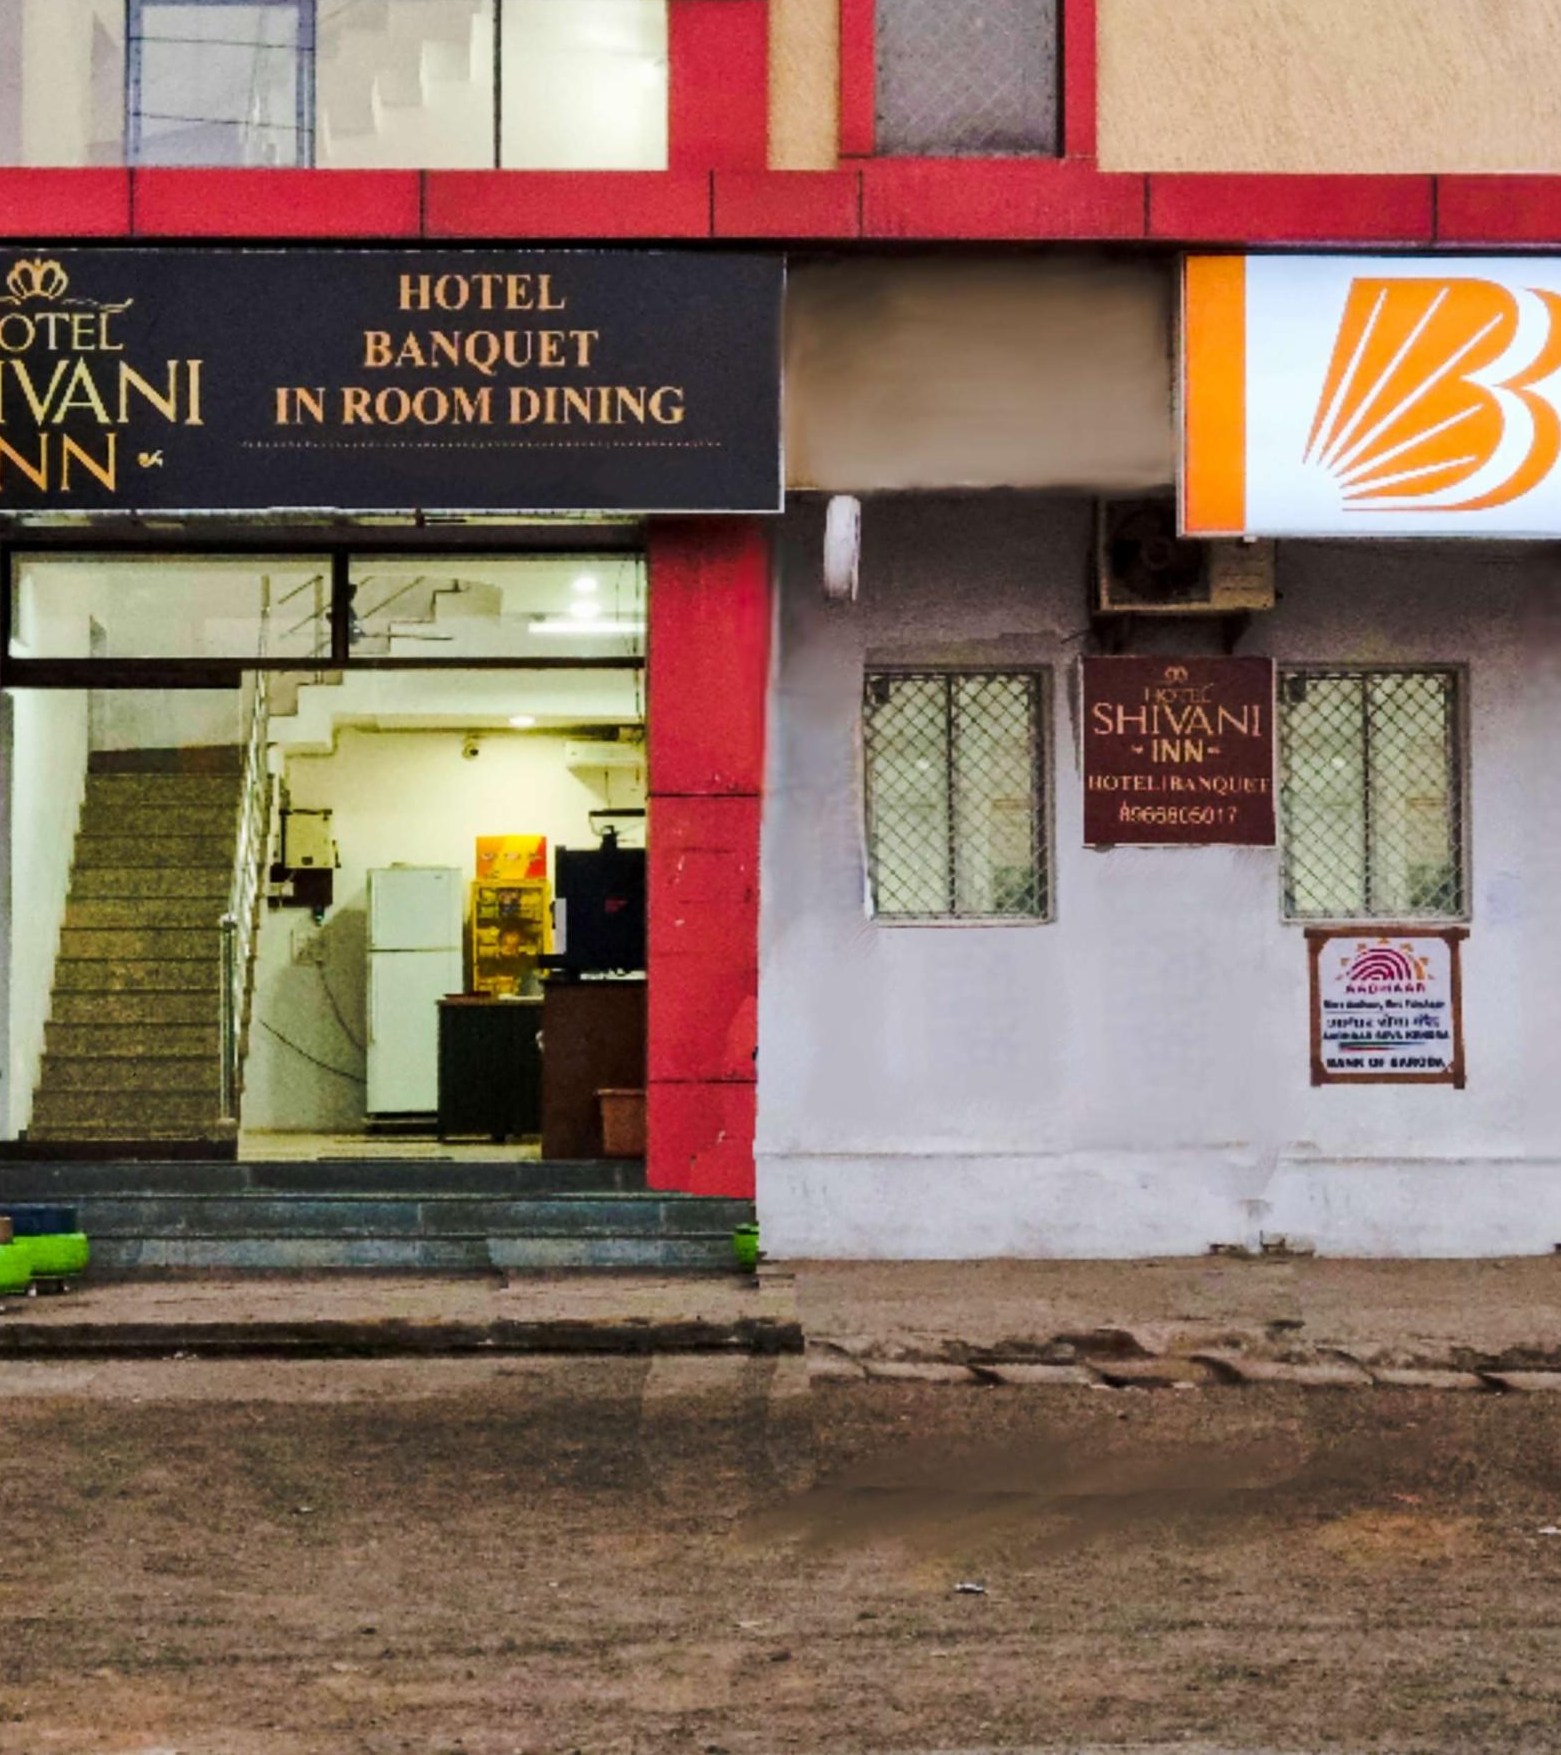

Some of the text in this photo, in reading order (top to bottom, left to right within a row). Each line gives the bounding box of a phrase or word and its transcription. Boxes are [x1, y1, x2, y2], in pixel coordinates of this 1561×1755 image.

[399, 274, 566, 311] HOTEL
[364, 329, 600, 373] BANQUET
[274, 386, 686, 426] IN ROOM DINING
[1145, 687, 1212, 704] HOTEL
[1092, 703, 1261, 737] SHIVANI
[1152, 739, 1204, 763] INN
